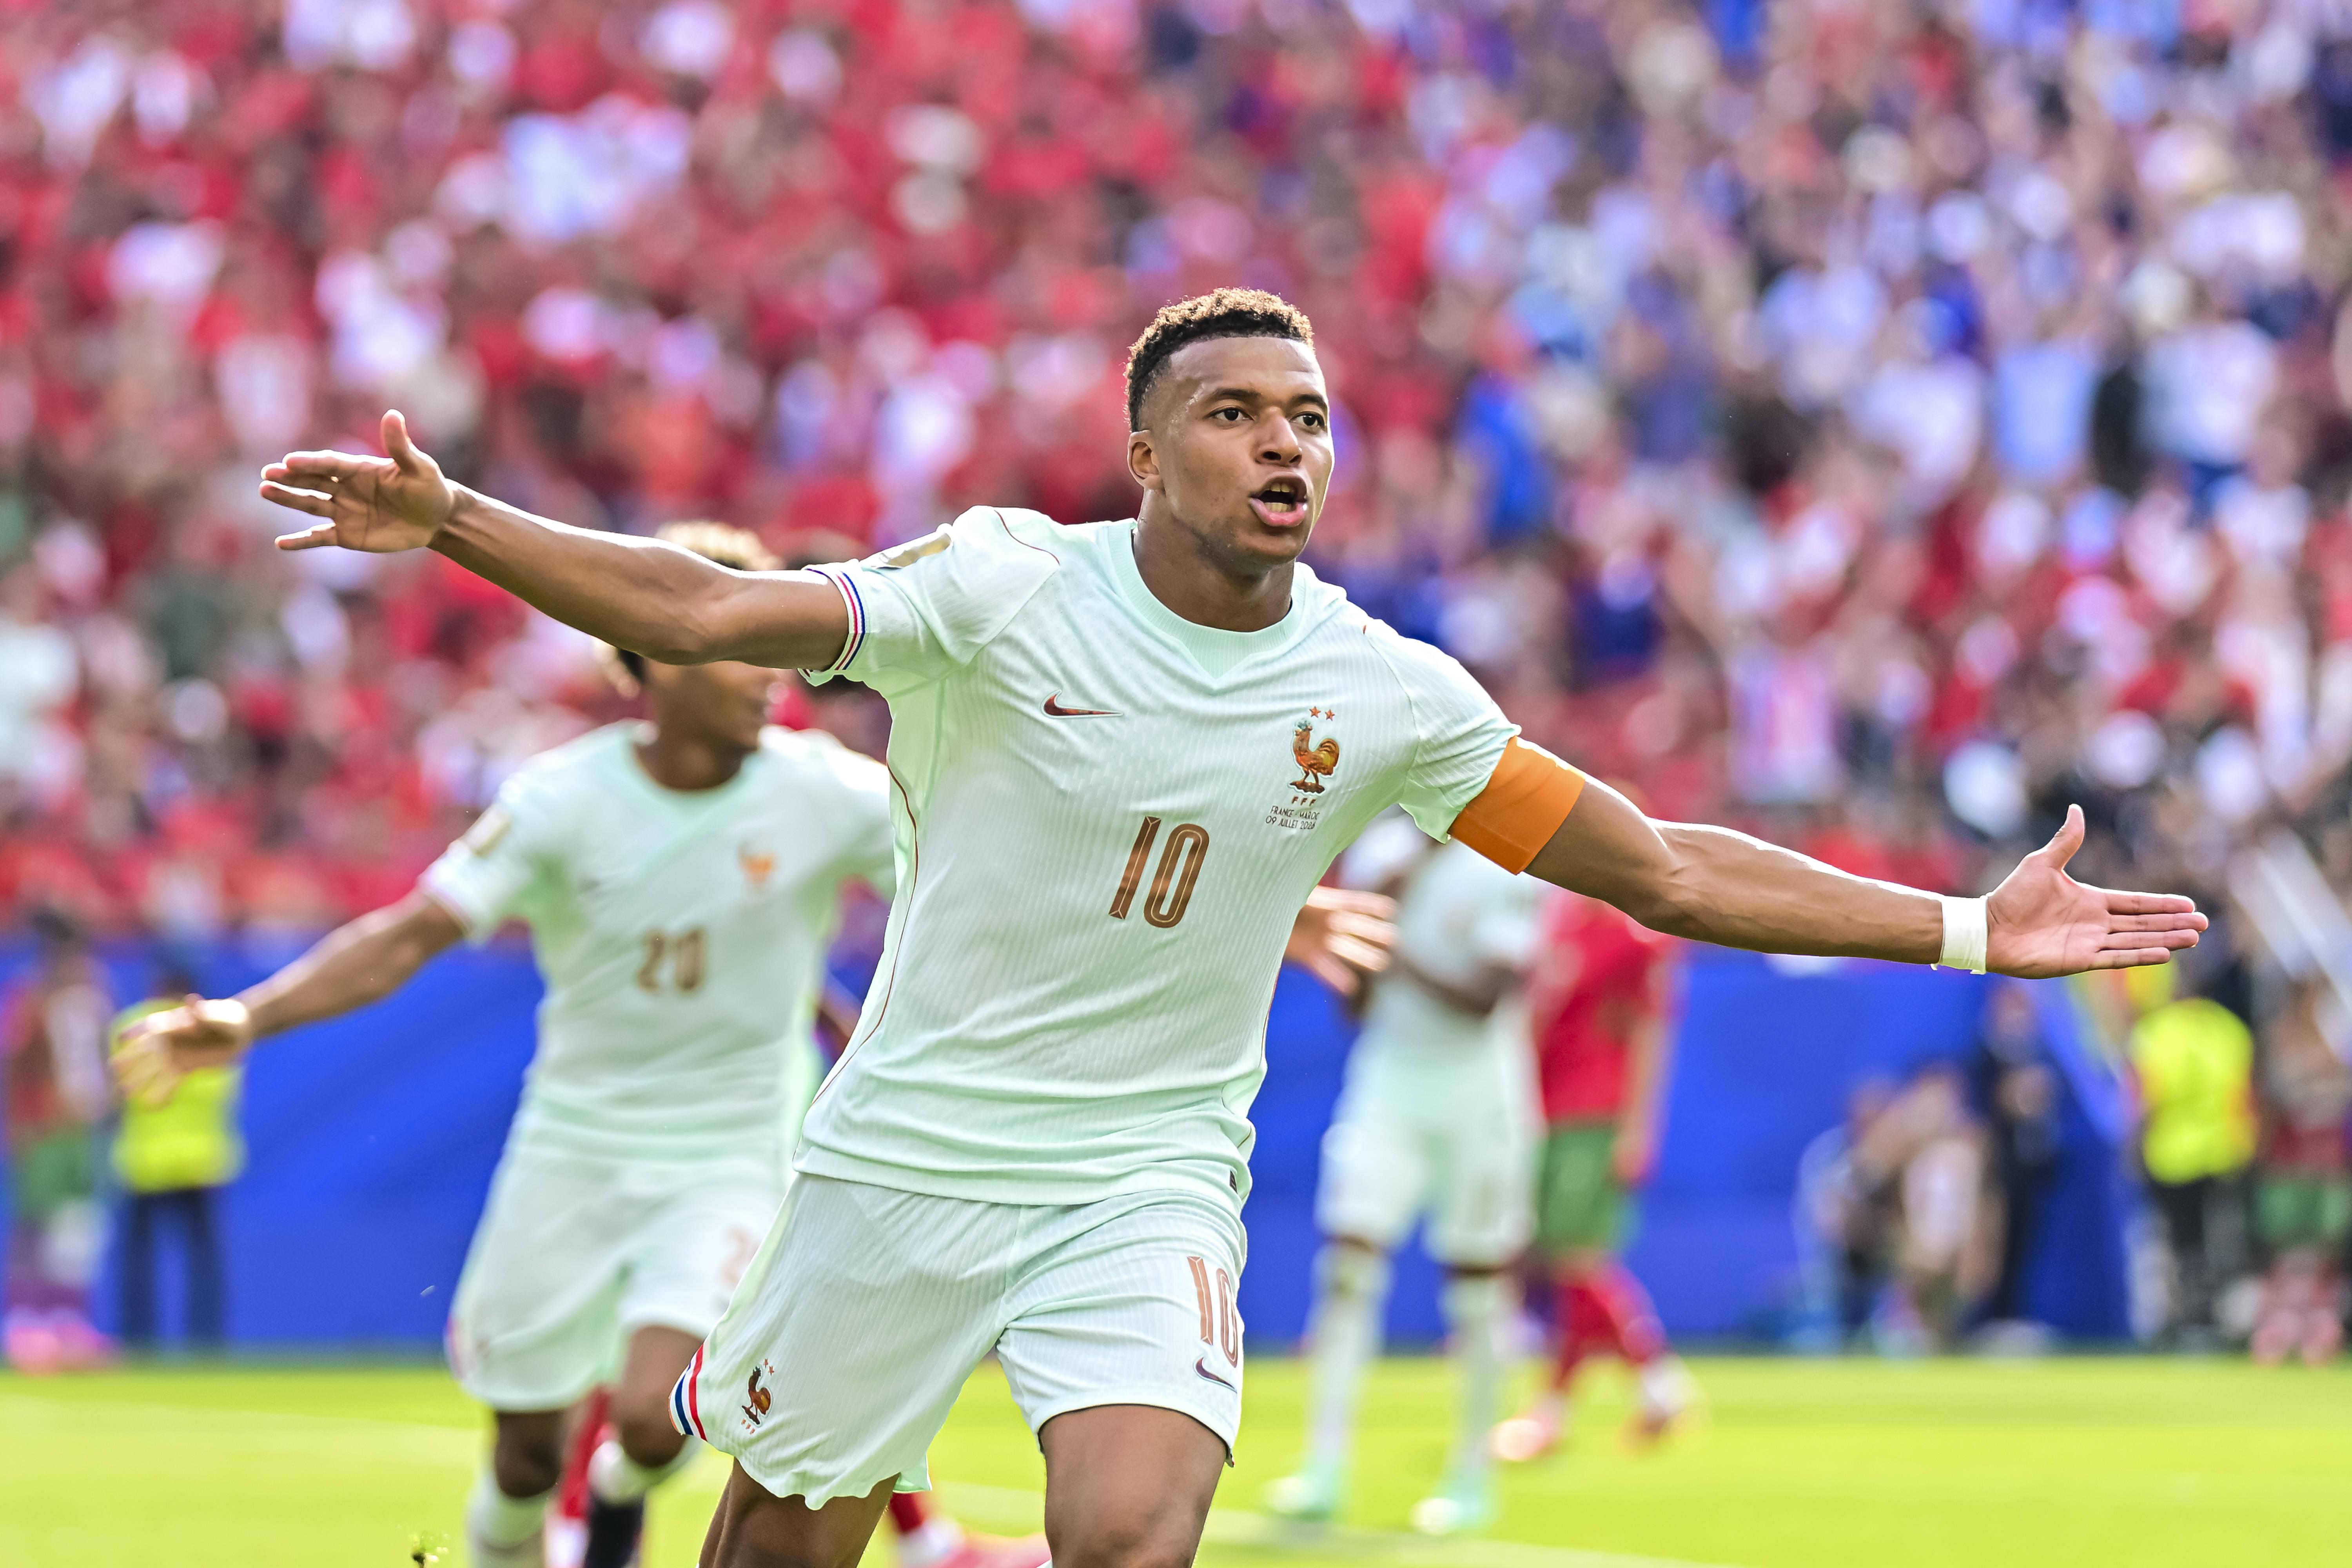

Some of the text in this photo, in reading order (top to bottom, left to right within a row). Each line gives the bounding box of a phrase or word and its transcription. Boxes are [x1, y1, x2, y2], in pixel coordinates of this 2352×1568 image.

[1266, 816, 1277, 824] 09
[1278, 818, 1298, 828] JUILLET
[1270, 806, 1294, 817] FRANCE
[1299, 811, 1320, 820] MAROC
[1109, 815, 1210, 928] 10
[636, 927, 706, 994] 20
[1187, 1256, 1238, 1368] 10
